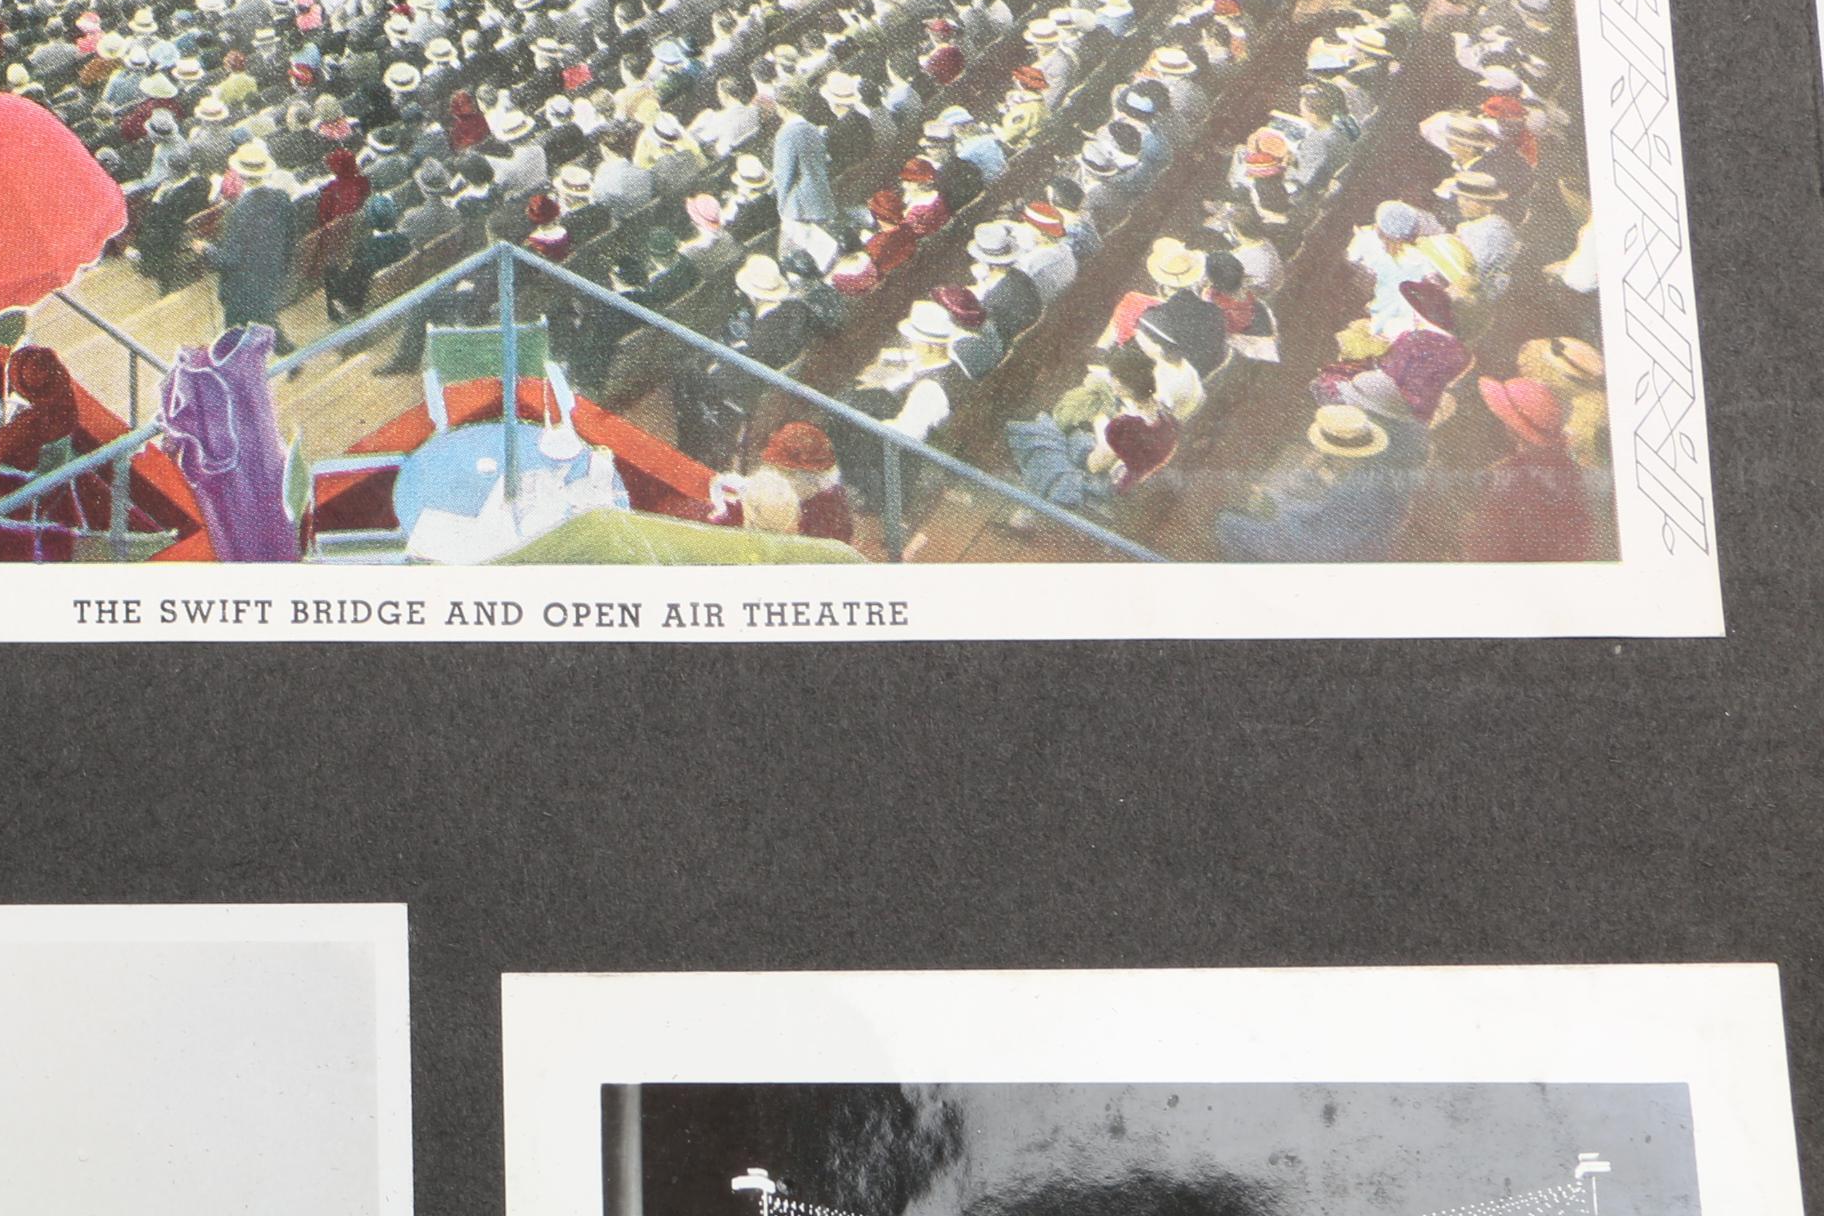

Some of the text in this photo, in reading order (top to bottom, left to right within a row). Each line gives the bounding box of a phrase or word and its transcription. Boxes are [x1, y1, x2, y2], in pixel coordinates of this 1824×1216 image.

[73, 599, 910, 627] THE SWIFT BRIDGE AND OPEN AIR THEATRE
